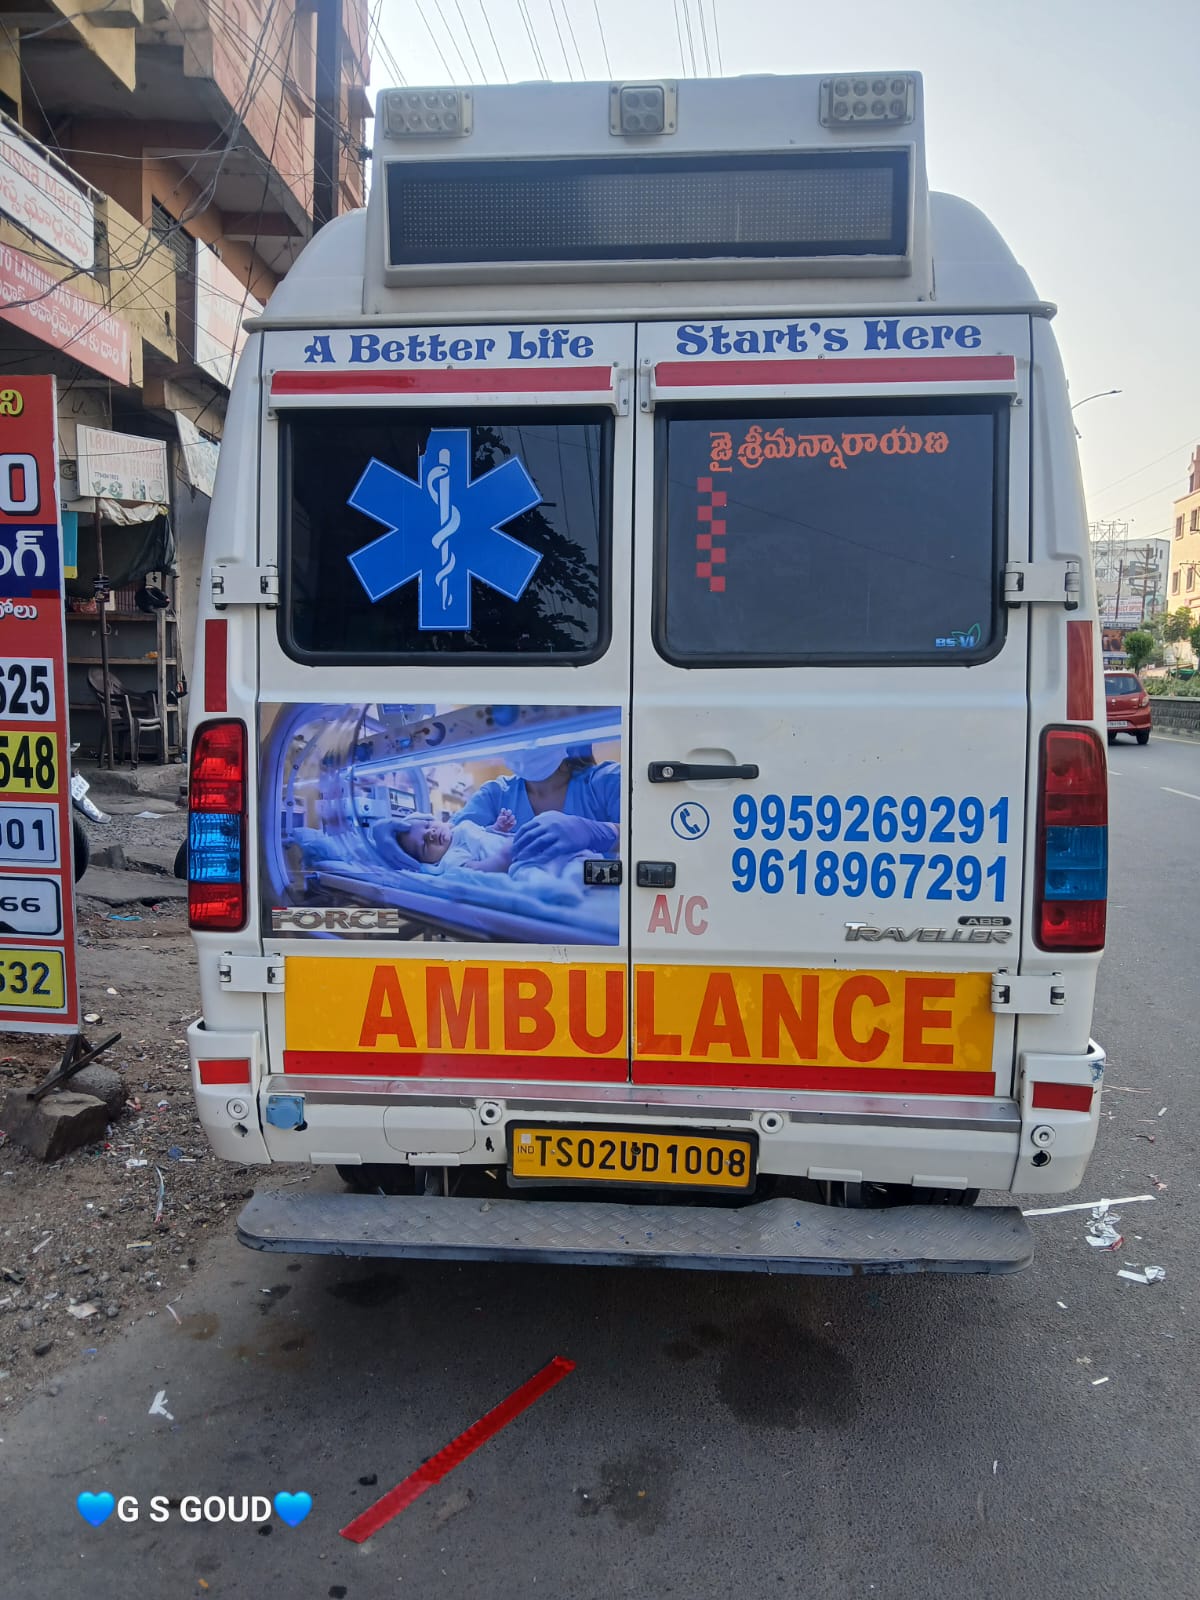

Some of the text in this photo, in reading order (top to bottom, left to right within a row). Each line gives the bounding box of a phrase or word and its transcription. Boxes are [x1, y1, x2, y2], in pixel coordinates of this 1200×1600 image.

[72, 298, 120, 339] APARTMENT
[304, 319, 982, 364] A Better Life Start's Here
[0, 818, 45, 851] 01
[732, 794, 1009, 844] 9959269291
[731, 847, 1007, 902] 9618967291
[272, 909, 399, 930] FORCE
[647, 894, 709, 935] A/C
[843, 922, 1013, 944] TRAVELLER
[965, 917, 1005, 926] ABS
[358, 965, 956, 1065] AMBULANCE
[517, 1145, 534, 1155] IND
[535, 1135, 746, 1177] TS02UD1008
